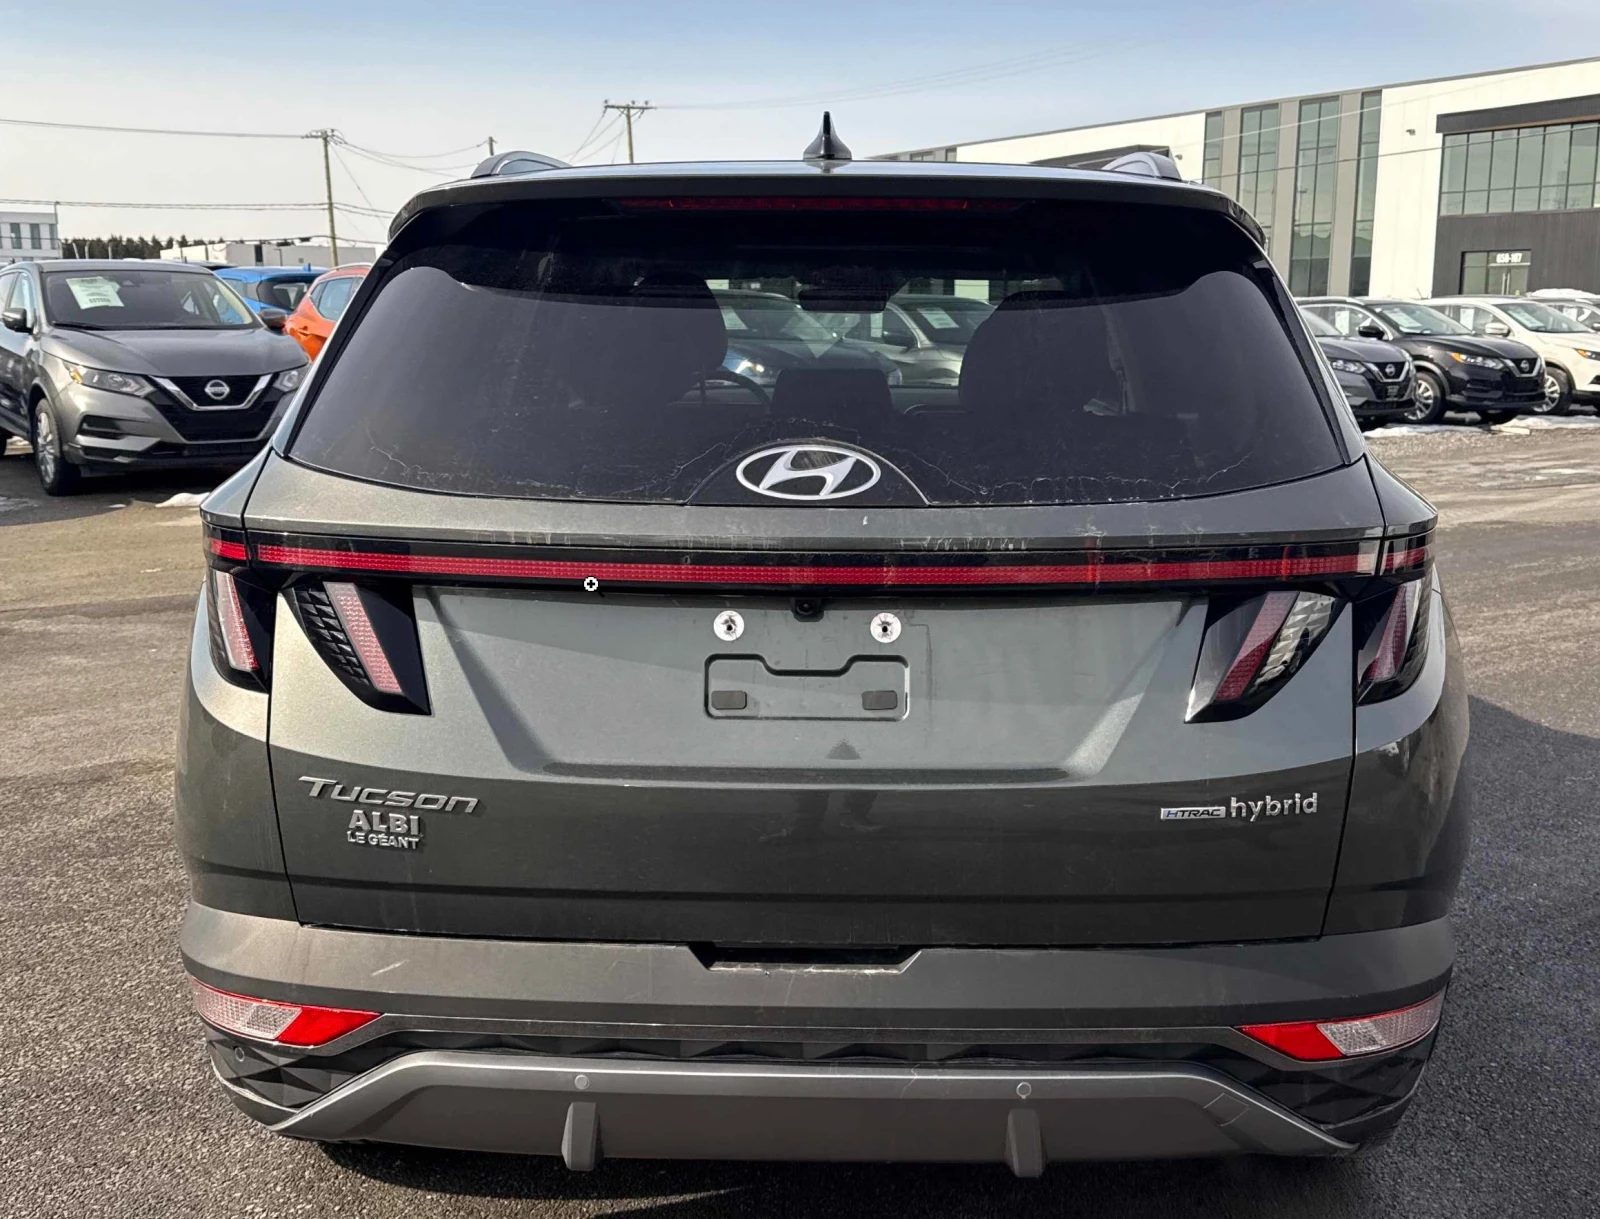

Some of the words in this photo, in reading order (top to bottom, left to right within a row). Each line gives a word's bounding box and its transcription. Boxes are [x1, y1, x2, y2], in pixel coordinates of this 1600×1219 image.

[298, 775, 479, 813] TUCSON
[1166, 809, 1221, 818] HTRAC
[1230, 792, 1318, 822] hybrid
[348, 809, 420, 835] ALBI
[346, 830, 366, 844] LE
